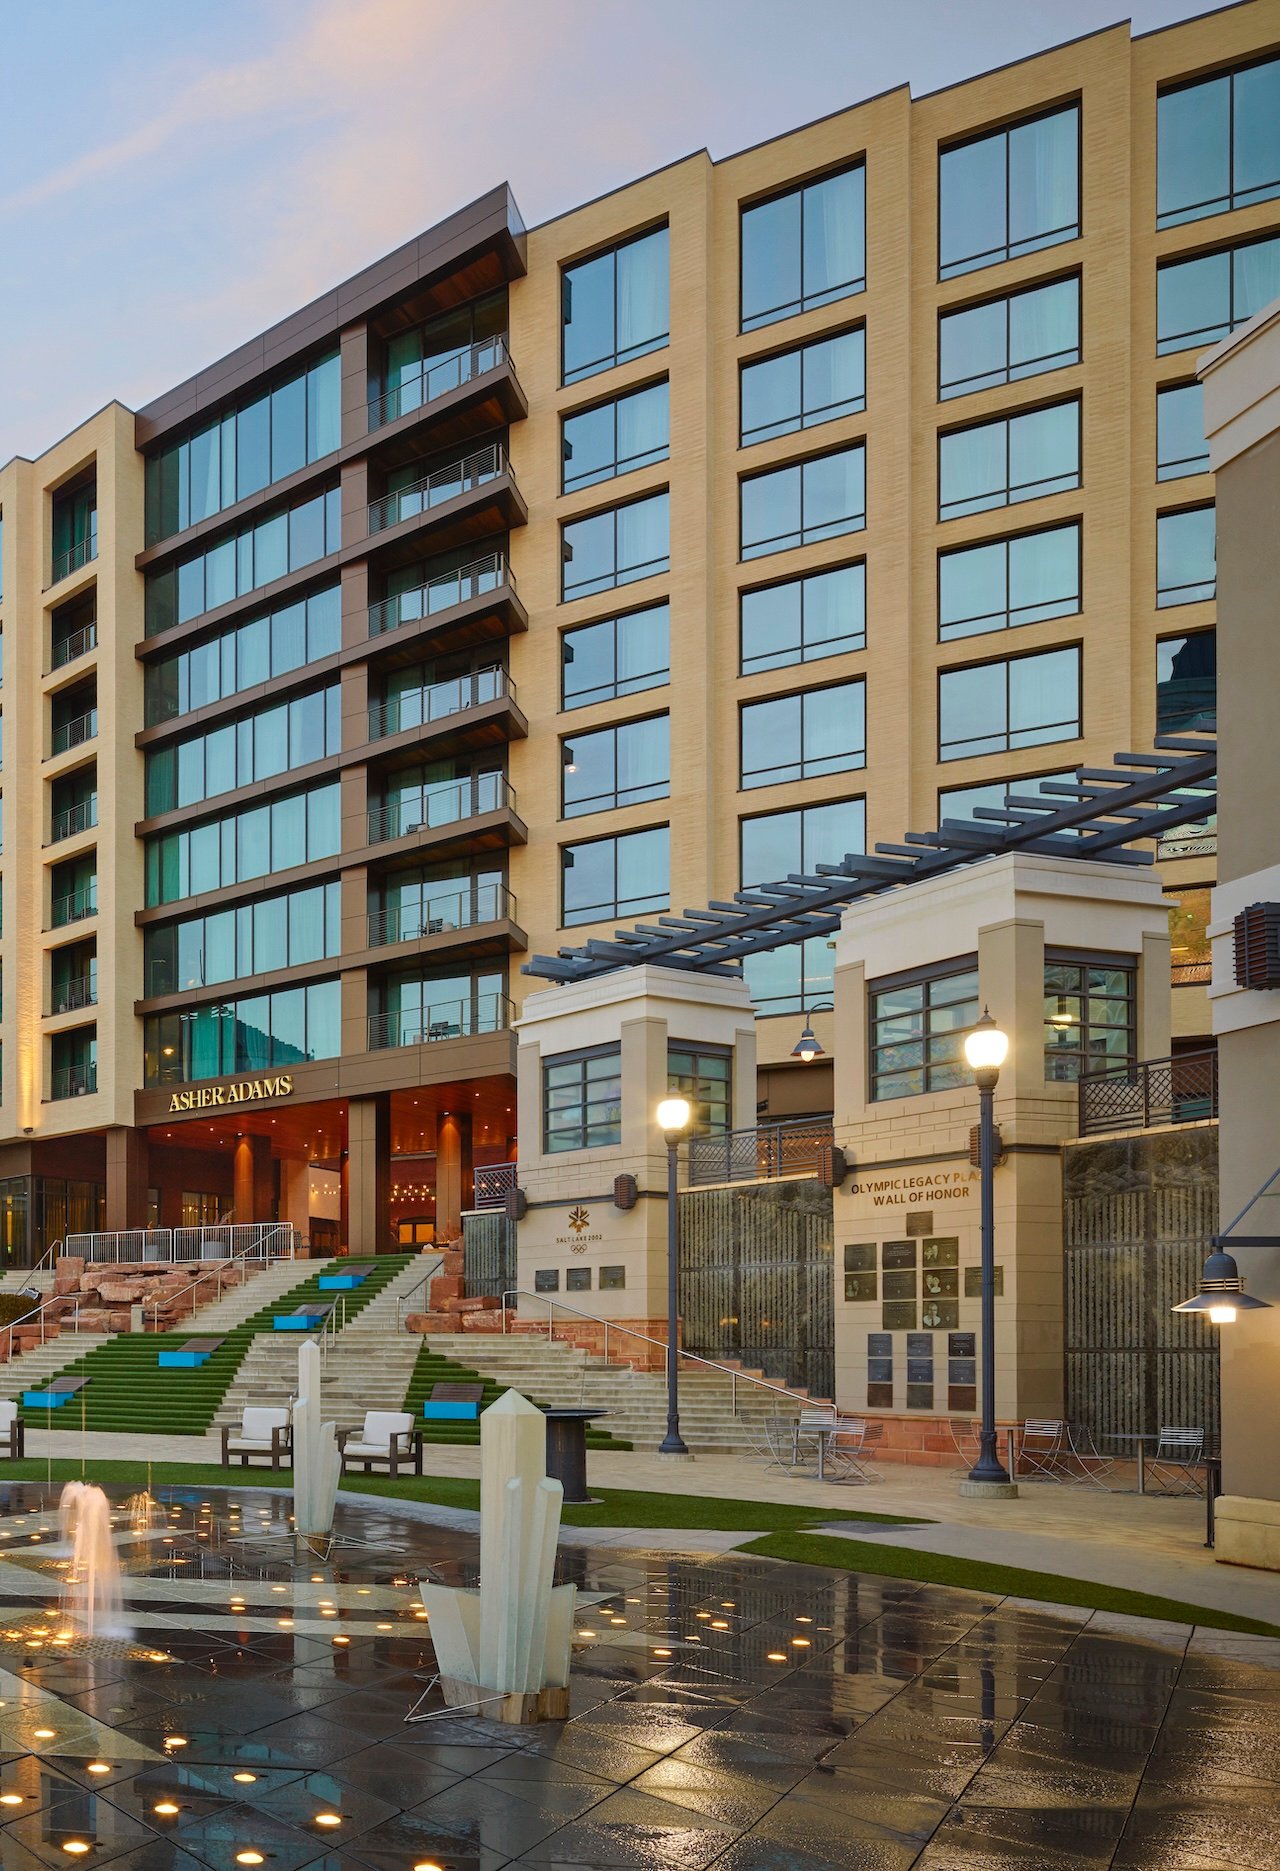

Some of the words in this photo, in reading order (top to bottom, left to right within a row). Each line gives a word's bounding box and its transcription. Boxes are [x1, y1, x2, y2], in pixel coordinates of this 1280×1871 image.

[168, 1087, 225, 1112] ASHER
[227, 1075, 293, 1103] ADAMS
[851, 1179, 901, 1195] OLYMPIC
[903, 1174, 951, 1189] LEGACY
[953, 1170, 987, 1183] PLA
[873, 1193, 907, 1206] WALL
[909, 1191, 924, 1203] OF
[926, 1186, 970, 1201] HONOR
